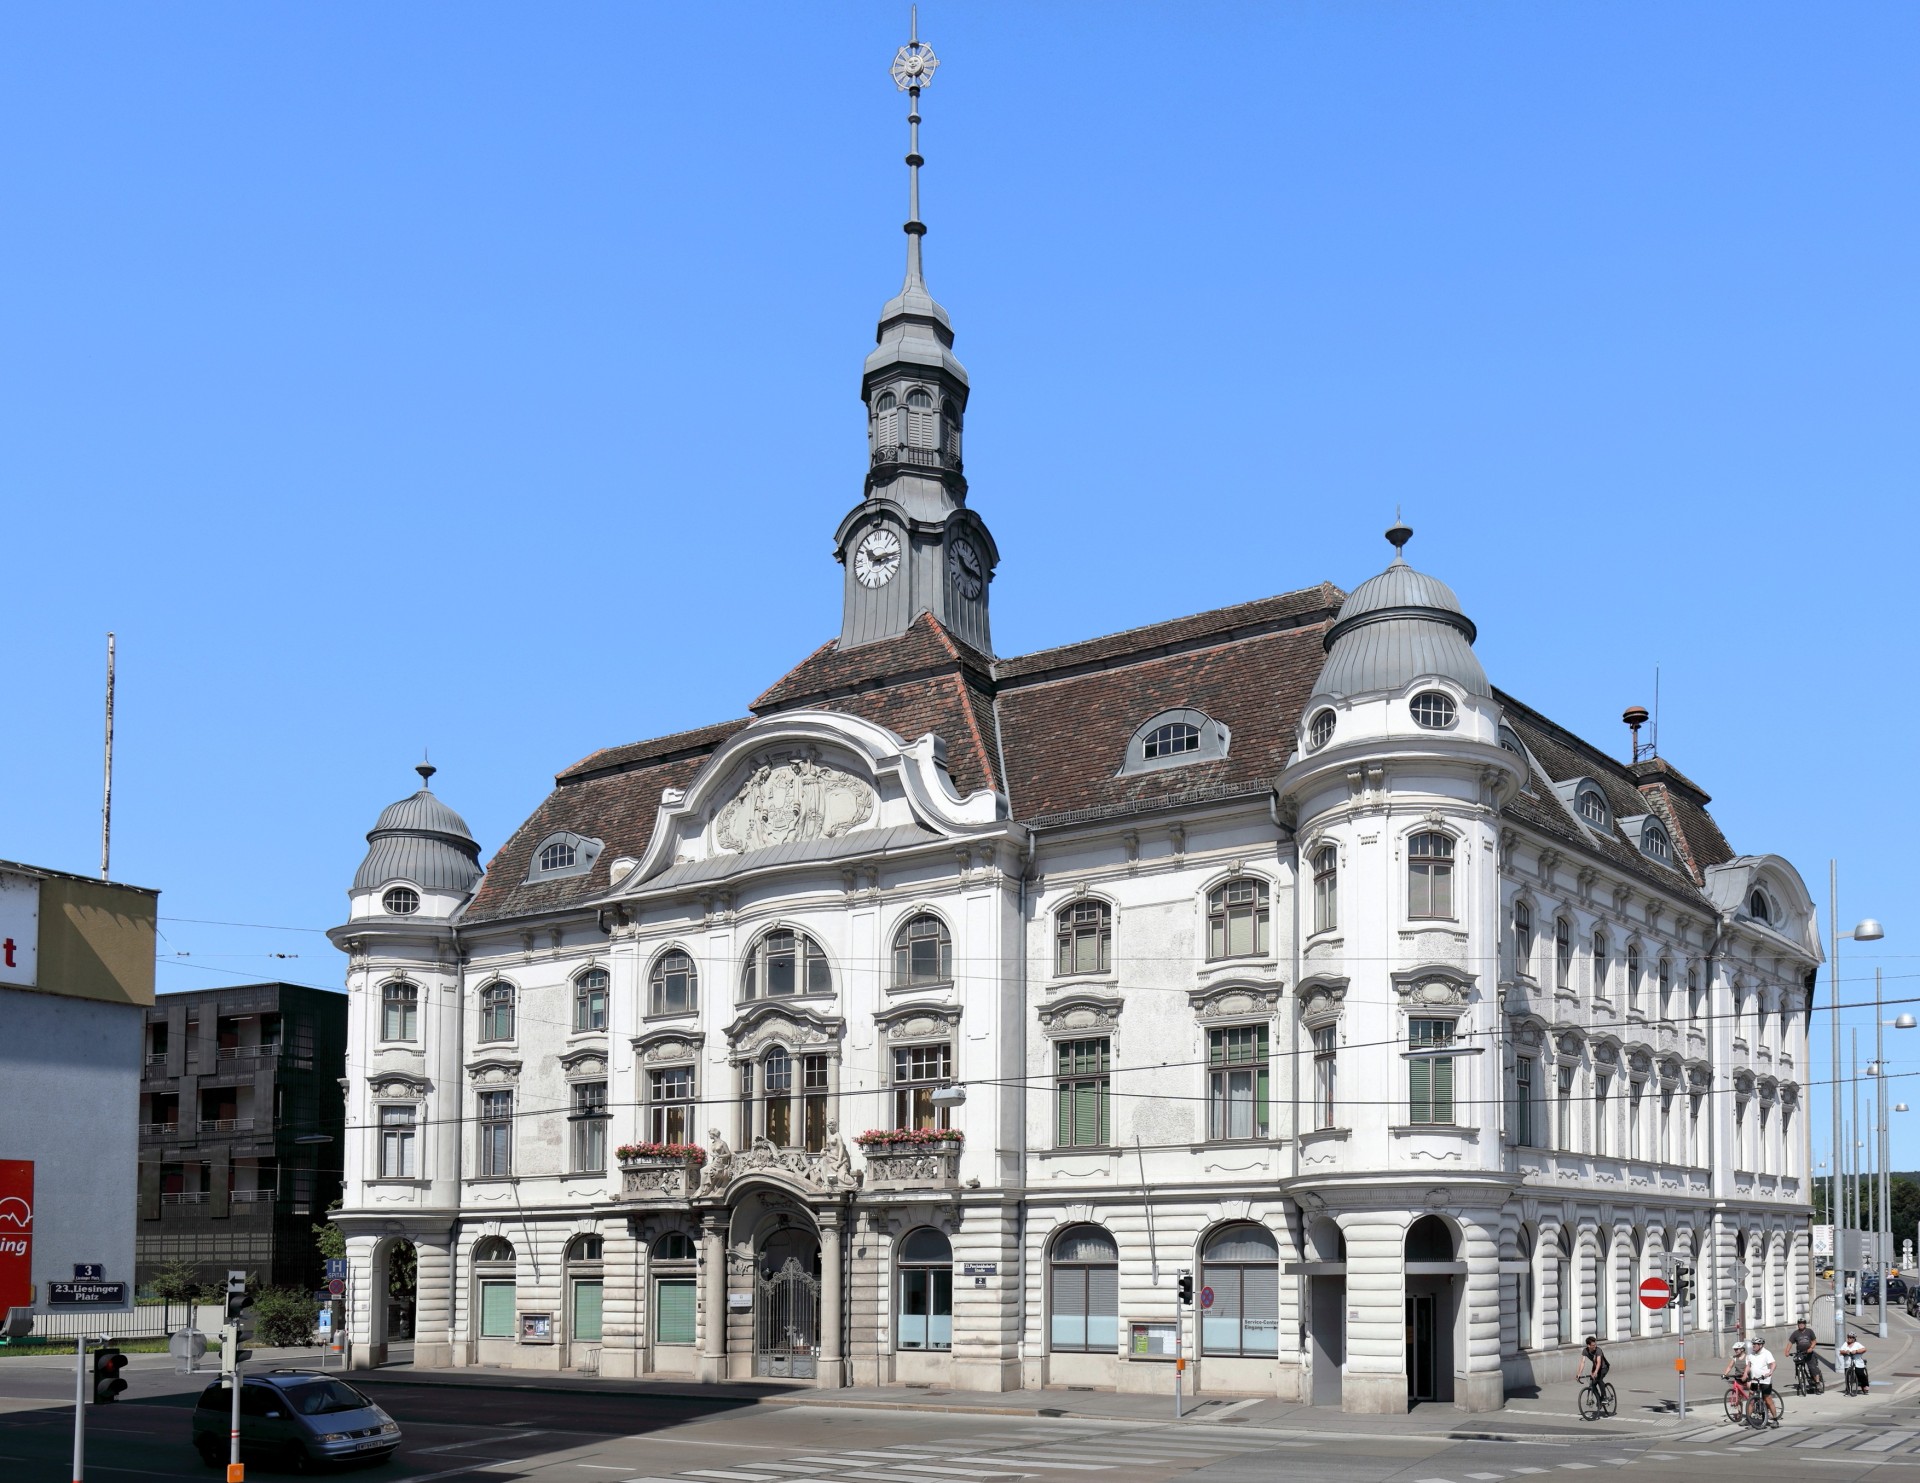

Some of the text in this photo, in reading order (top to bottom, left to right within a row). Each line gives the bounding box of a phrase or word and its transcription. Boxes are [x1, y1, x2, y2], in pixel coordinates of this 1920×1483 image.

[3, 937, 17, 968] t
[84, 1265, 92, 1276] 3
[332, 1261, 342, 1272] H
